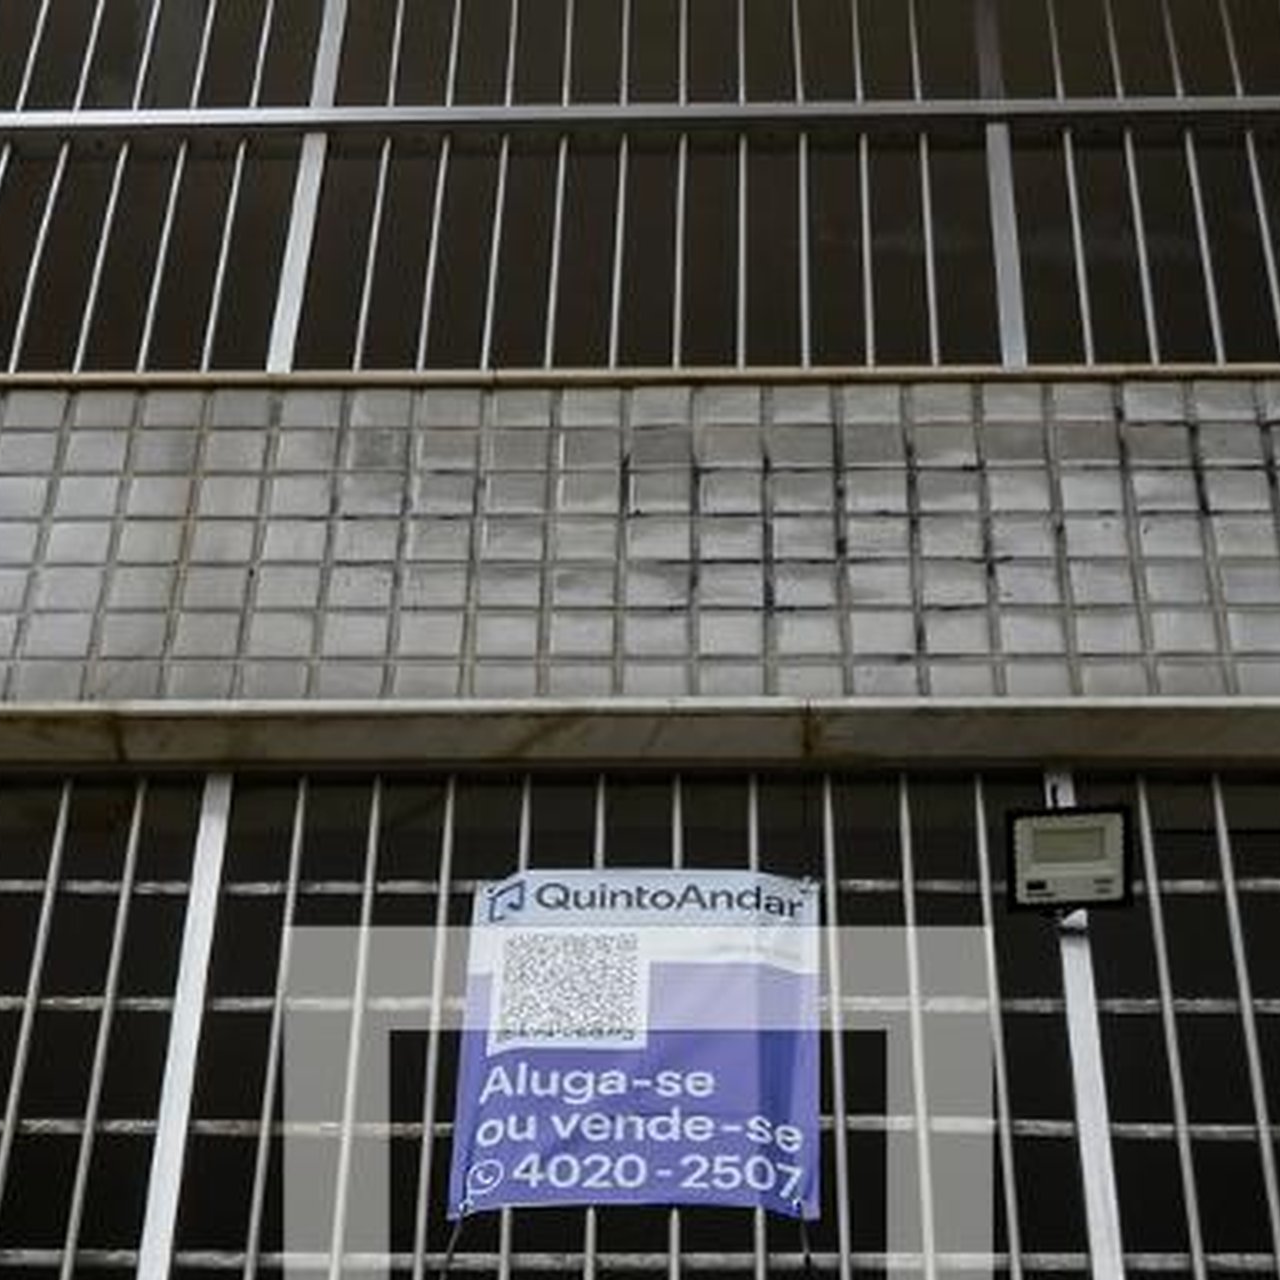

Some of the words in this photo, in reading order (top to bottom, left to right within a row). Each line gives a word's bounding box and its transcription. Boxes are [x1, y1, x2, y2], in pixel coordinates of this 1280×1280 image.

[534, 881, 804, 919] QuintoAndar
[478, 1063, 716, 1106] Aluga-se
[475, 1113, 536, 1148] ou
[551, 1106, 804, 1152] vende-se
[512, 1153, 804, 1199] 4020-2507
